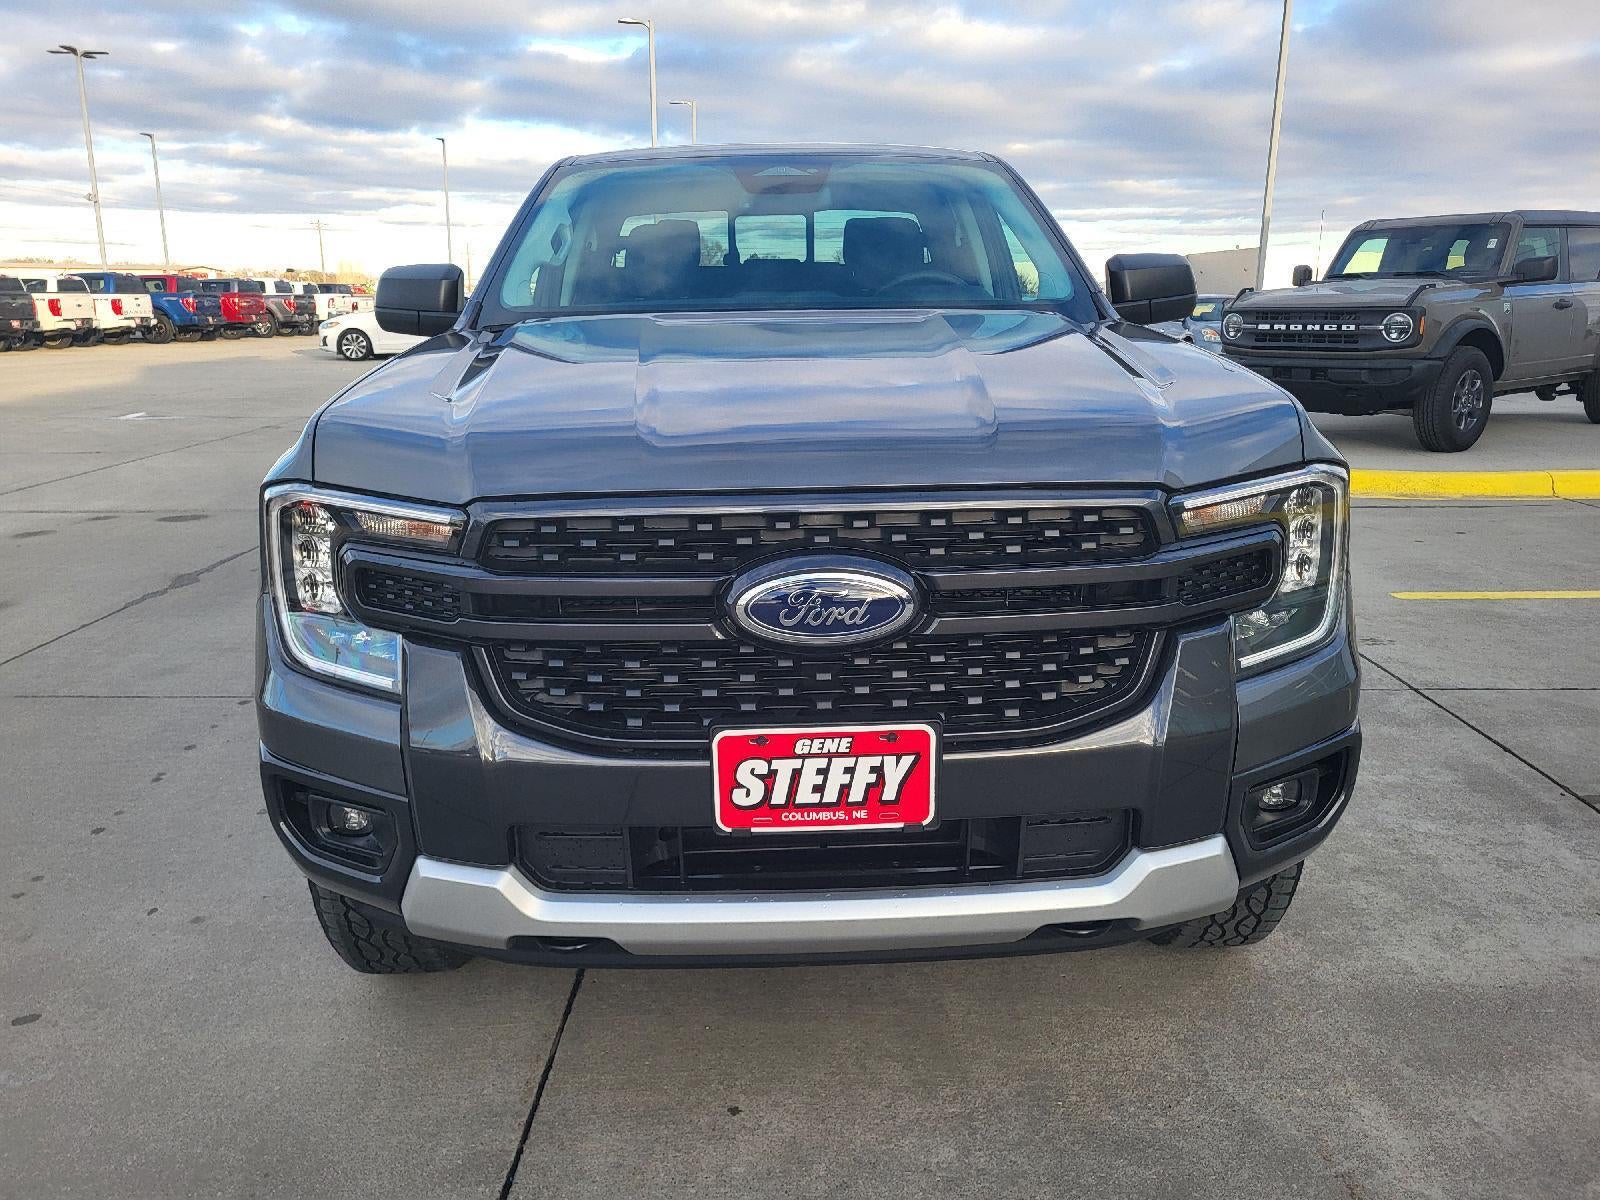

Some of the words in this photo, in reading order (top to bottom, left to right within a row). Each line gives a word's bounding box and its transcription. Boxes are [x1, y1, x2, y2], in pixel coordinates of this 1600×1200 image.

[1257, 323, 1356, 331] BRONCO
[778, 589, 873, 627] Ford
[794, 737, 852, 754] GENE
[731, 754, 918, 808] STEFFY
[781, 811, 849, 821] COLUMBUS,
[852, 809, 868, 819] NE
